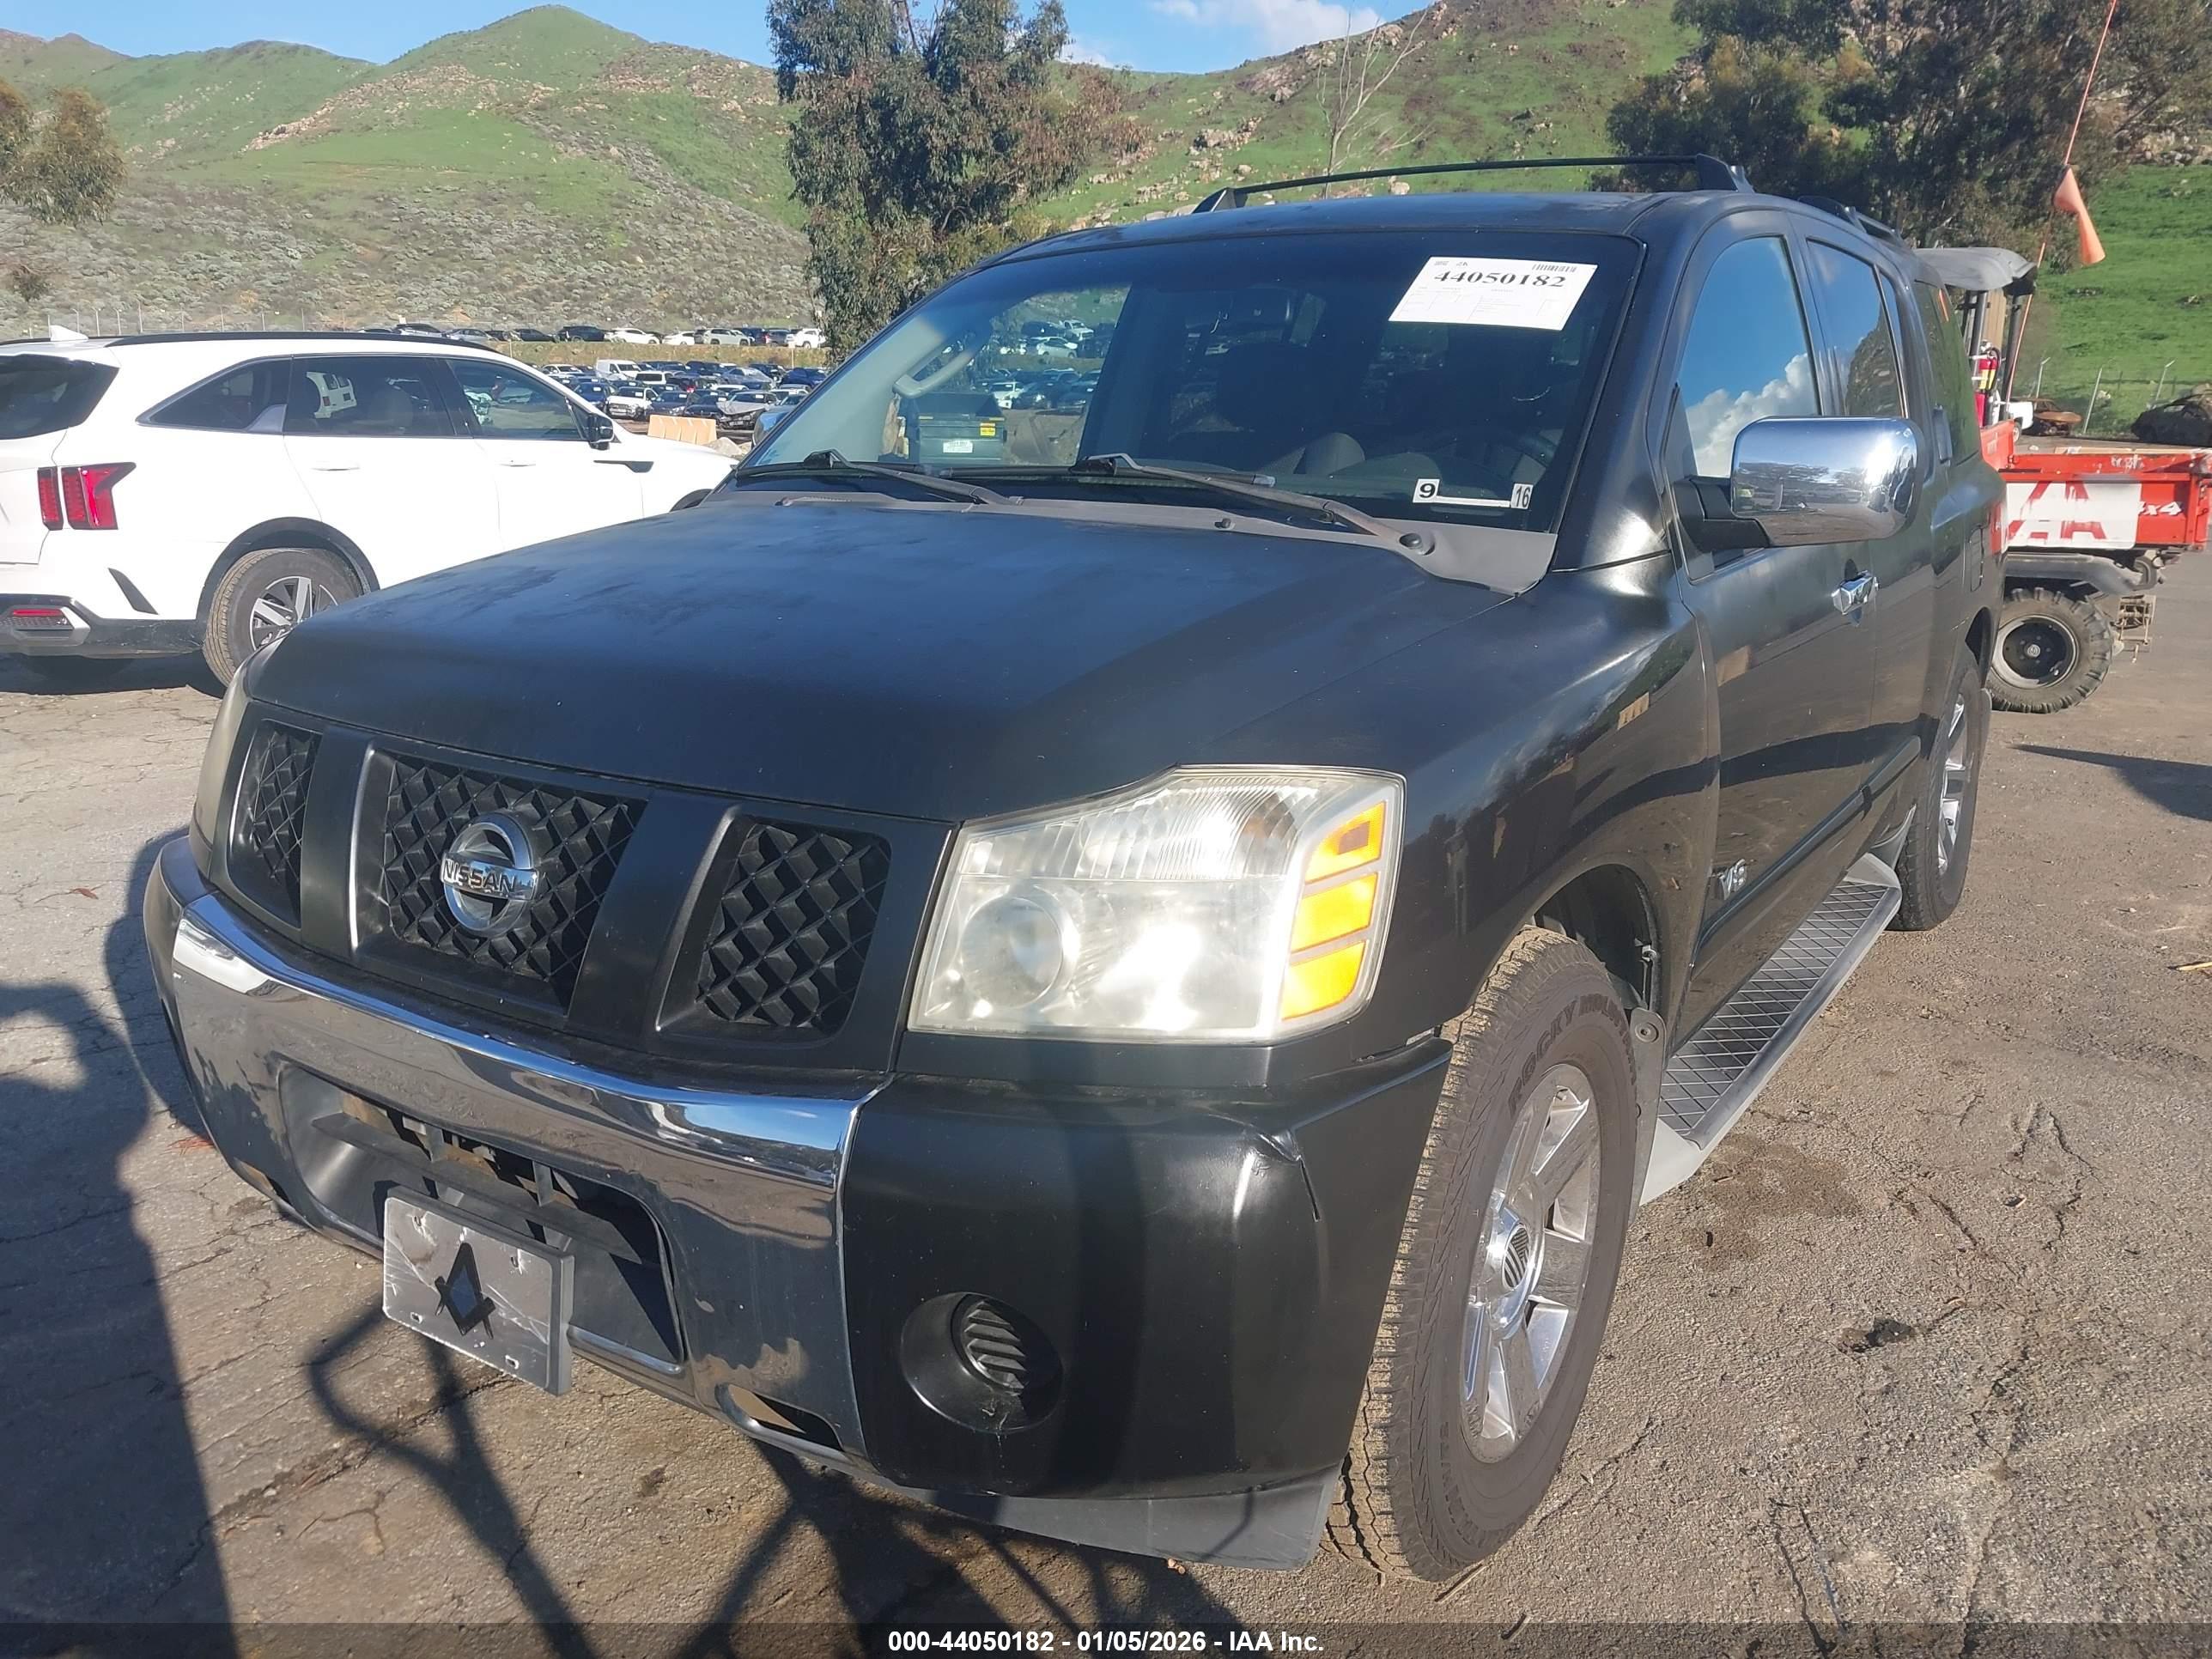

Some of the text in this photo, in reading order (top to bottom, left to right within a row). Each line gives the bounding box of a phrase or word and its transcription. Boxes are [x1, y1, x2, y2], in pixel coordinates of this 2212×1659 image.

[1433, 264, 1566, 288] 44050182
[1419, 483, 1436, 499] 9
[1515, 486, 1531, 508] 16
[442, 858, 517, 895] NISSAN
